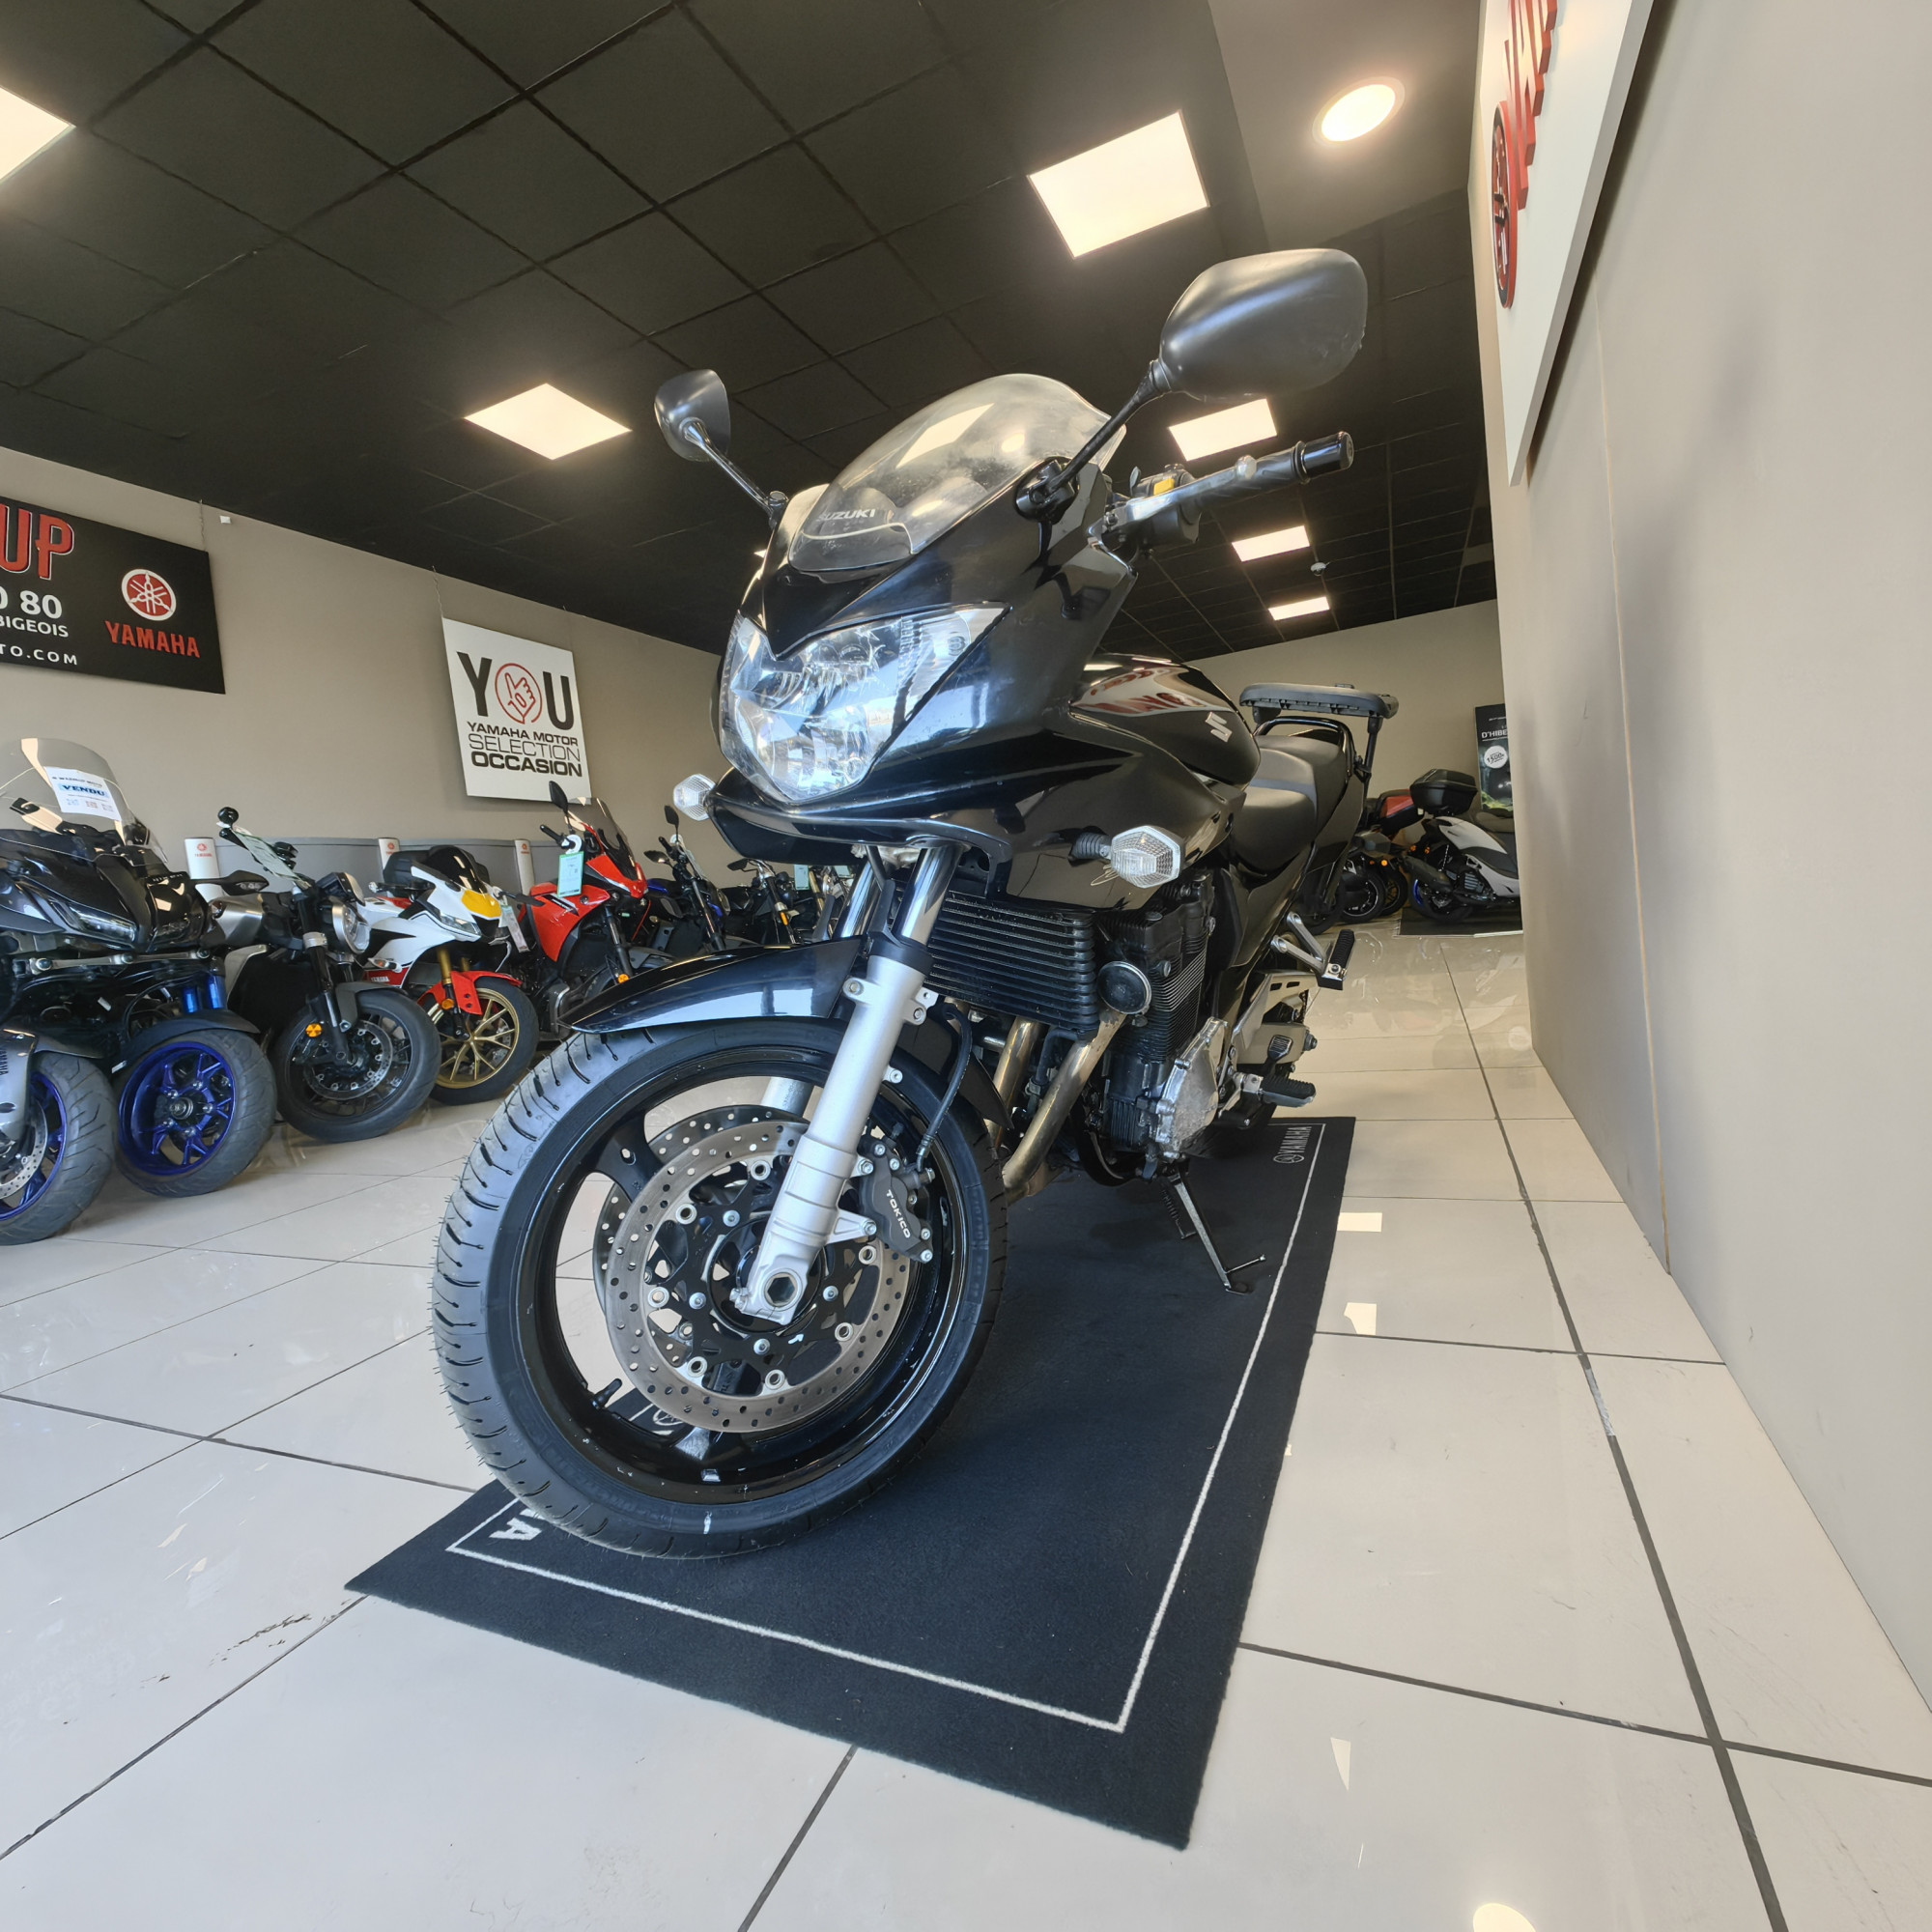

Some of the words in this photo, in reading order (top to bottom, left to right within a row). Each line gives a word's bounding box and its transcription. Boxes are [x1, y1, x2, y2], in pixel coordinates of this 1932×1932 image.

[815, 508, 876, 522] SUZUKI
[19, 589, 63, 619] 80
[104, 620, 201, 659] YAMAHA
[467, 721, 530, 740] YAMAHA
[532, 731, 579, 747] MOTOR
[468, 733, 581, 762] SELECTION
[470, 751, 582, 778] OCCASION
[62, 784, 105, 797] VENDU
[1277, 1125, 1313, 1154] YAMAHA
[885, 1188, 911, 1238] TOKICO
